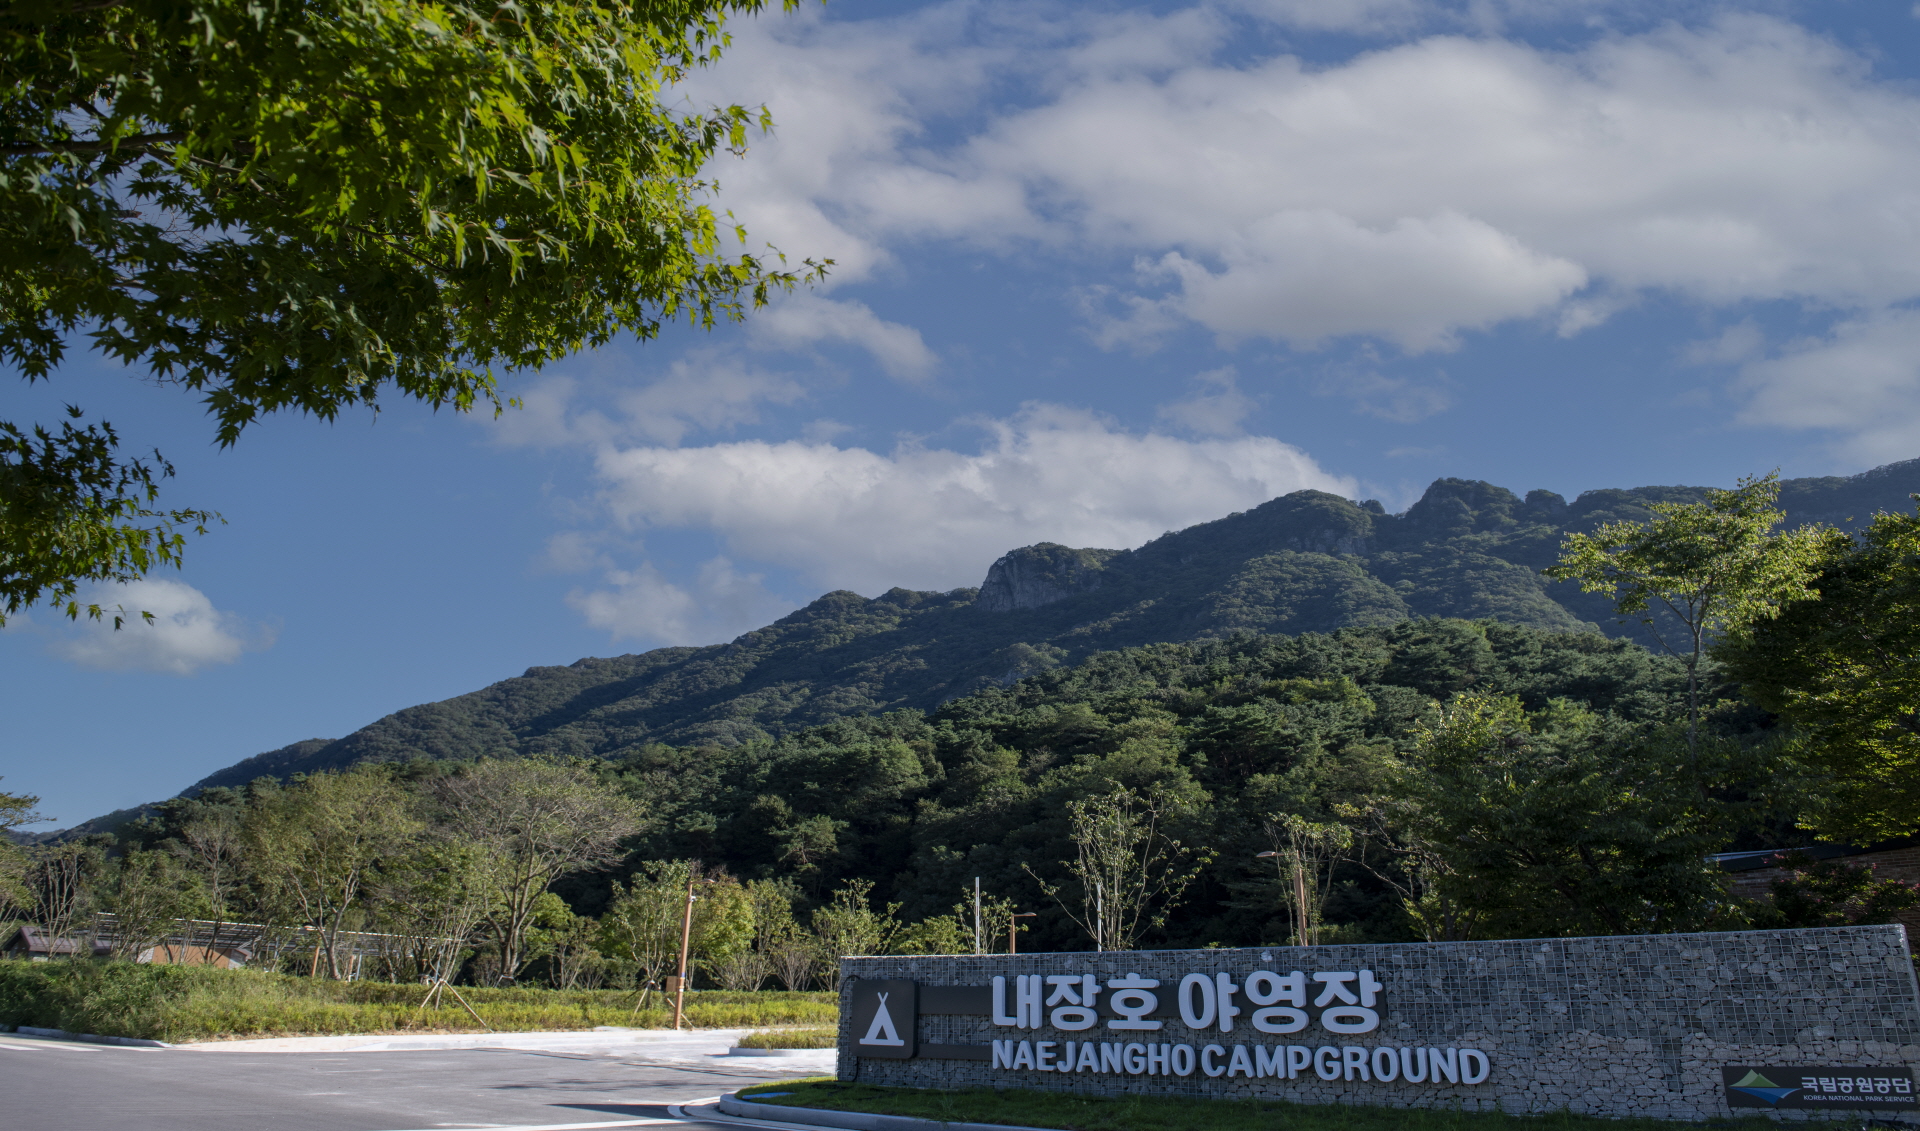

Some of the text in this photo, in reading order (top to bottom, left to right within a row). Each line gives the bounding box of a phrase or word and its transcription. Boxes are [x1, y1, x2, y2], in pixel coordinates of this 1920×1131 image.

[992, 969, 1383, 1034] 내장호 야영장
[992, 1039, 1491, 1085] NAEJANGHO CAMPGROUND
[1802, 1077, 1911, 1094] 국립공원공단
